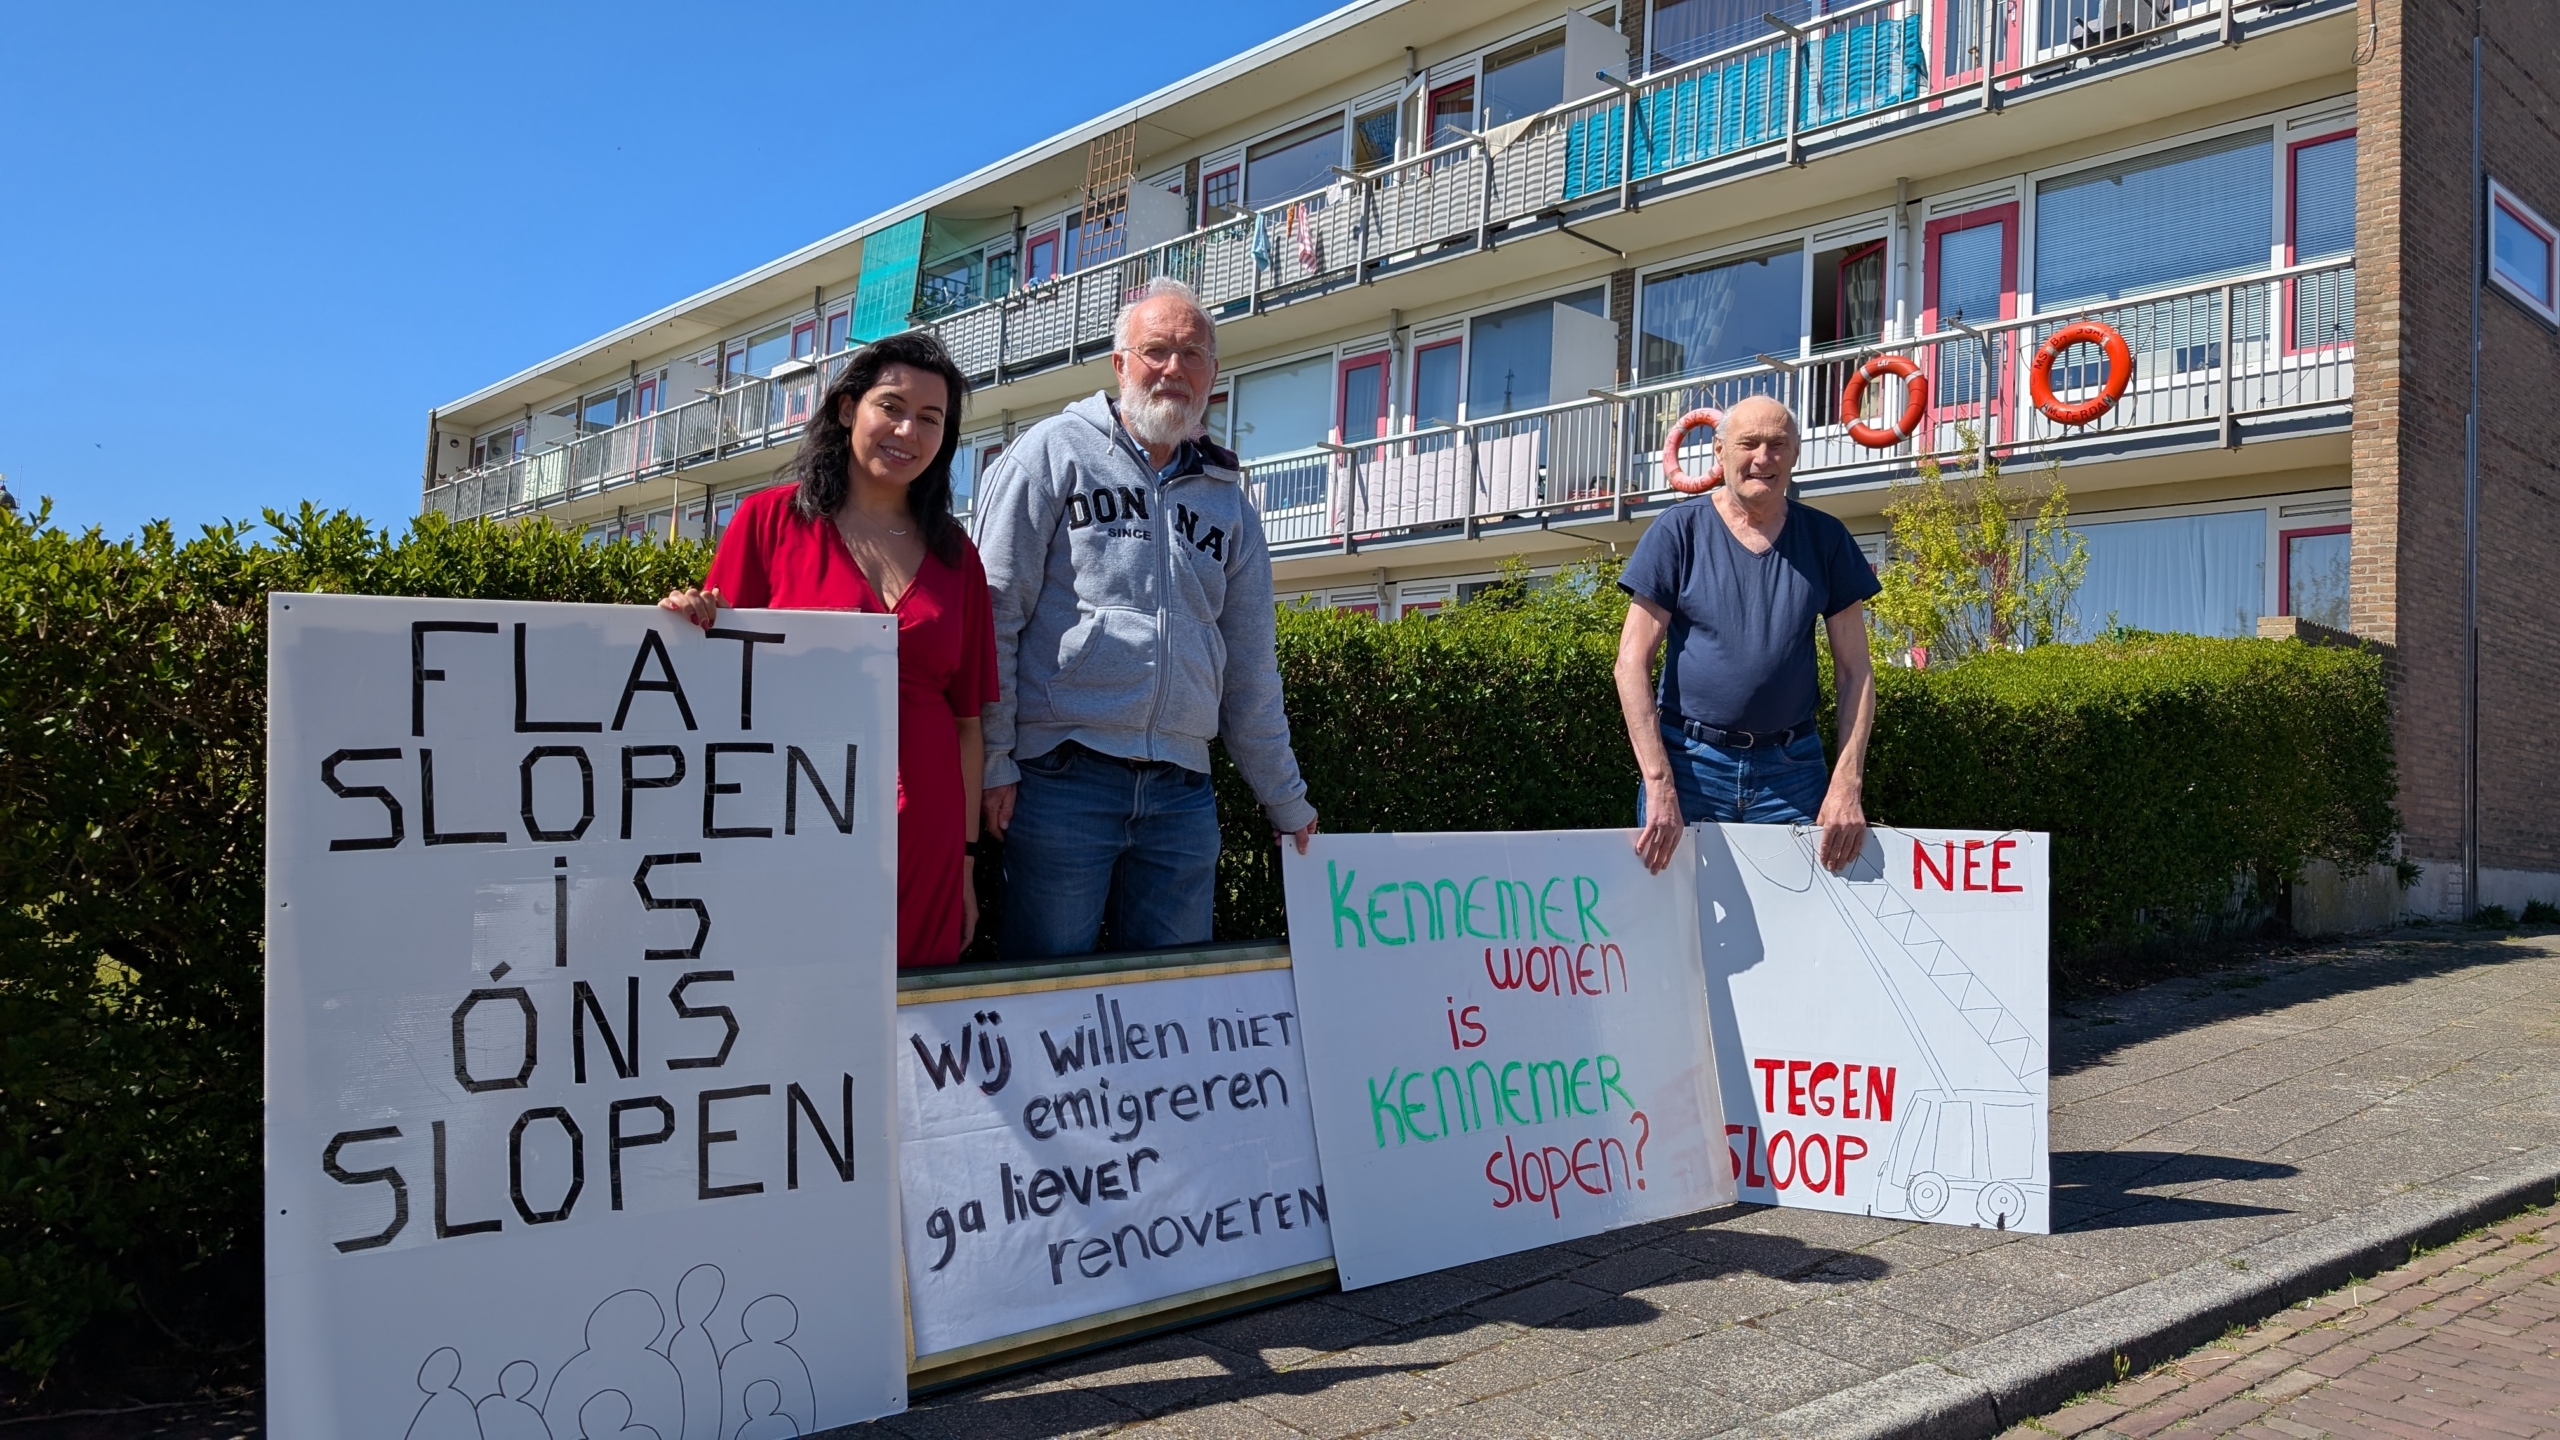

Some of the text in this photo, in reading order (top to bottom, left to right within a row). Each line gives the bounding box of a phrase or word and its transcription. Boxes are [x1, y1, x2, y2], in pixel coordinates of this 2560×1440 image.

[1107, 527, 1152, 541] SINCE
[1174, 502, 1231, 562] NA
[411, 621, 787, 737] FLAT
[320, 741, 858, 852] SLOPEN
[1913, 839, 2024, 894] NEE
[451, 962, 741, 1094] ÓNS
[909, 1009, 1013, 1096] Wij
[1039, 993, 1190, 1077] willen
[1446, 996, 1488, 1050] is
[1023, 1066, 1290, 1143] emigreren
[1753, 1058, 1897, 1122] TEGEN
[321, 1072, 855, 1254] SLOPEN
[1485, 1110, 1651, 1219] slopen?
[1724, 1124, 1869, 1197] SLOOP
[925, 1200, 988, 1273] ga
